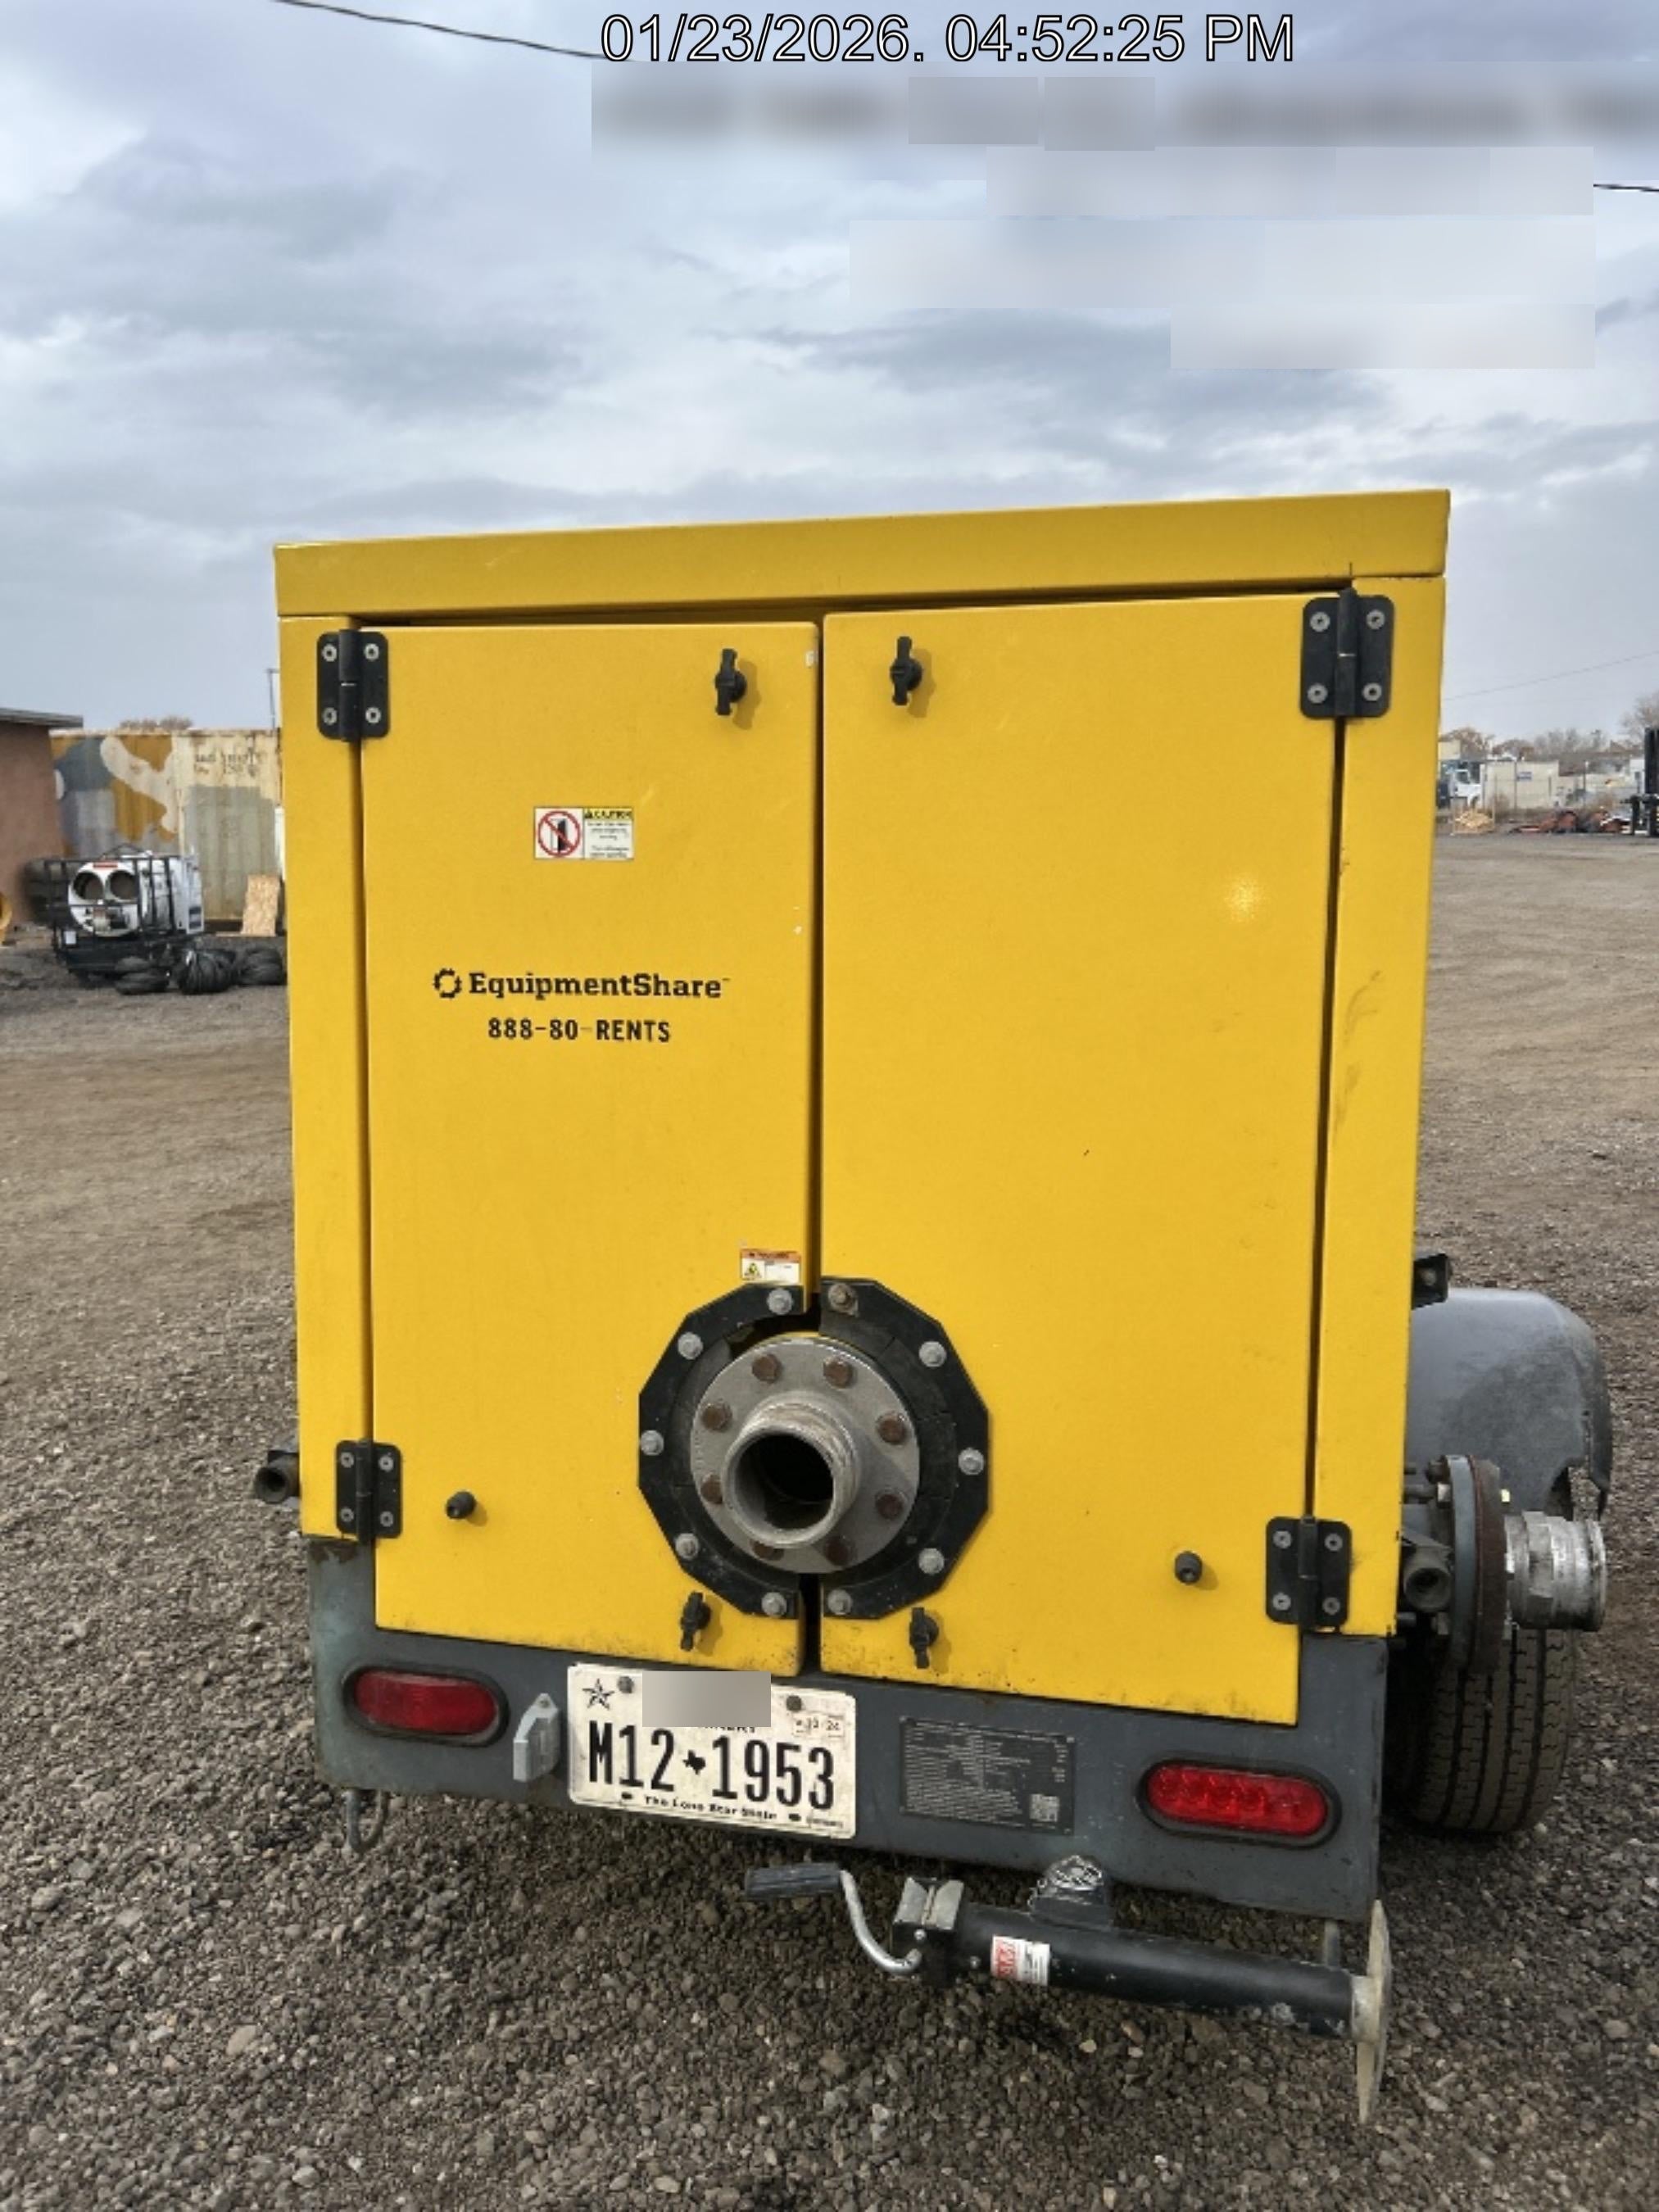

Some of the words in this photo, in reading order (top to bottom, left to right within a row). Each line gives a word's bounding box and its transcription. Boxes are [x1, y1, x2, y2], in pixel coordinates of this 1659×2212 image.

[469, 972, 722, 1000] EquipmentShare
[488, 1018, 670, 1043] 888-80-RENTS
[589, 1720, 675, 1793] M12
[712, 1734, 834, 1811] 1953
